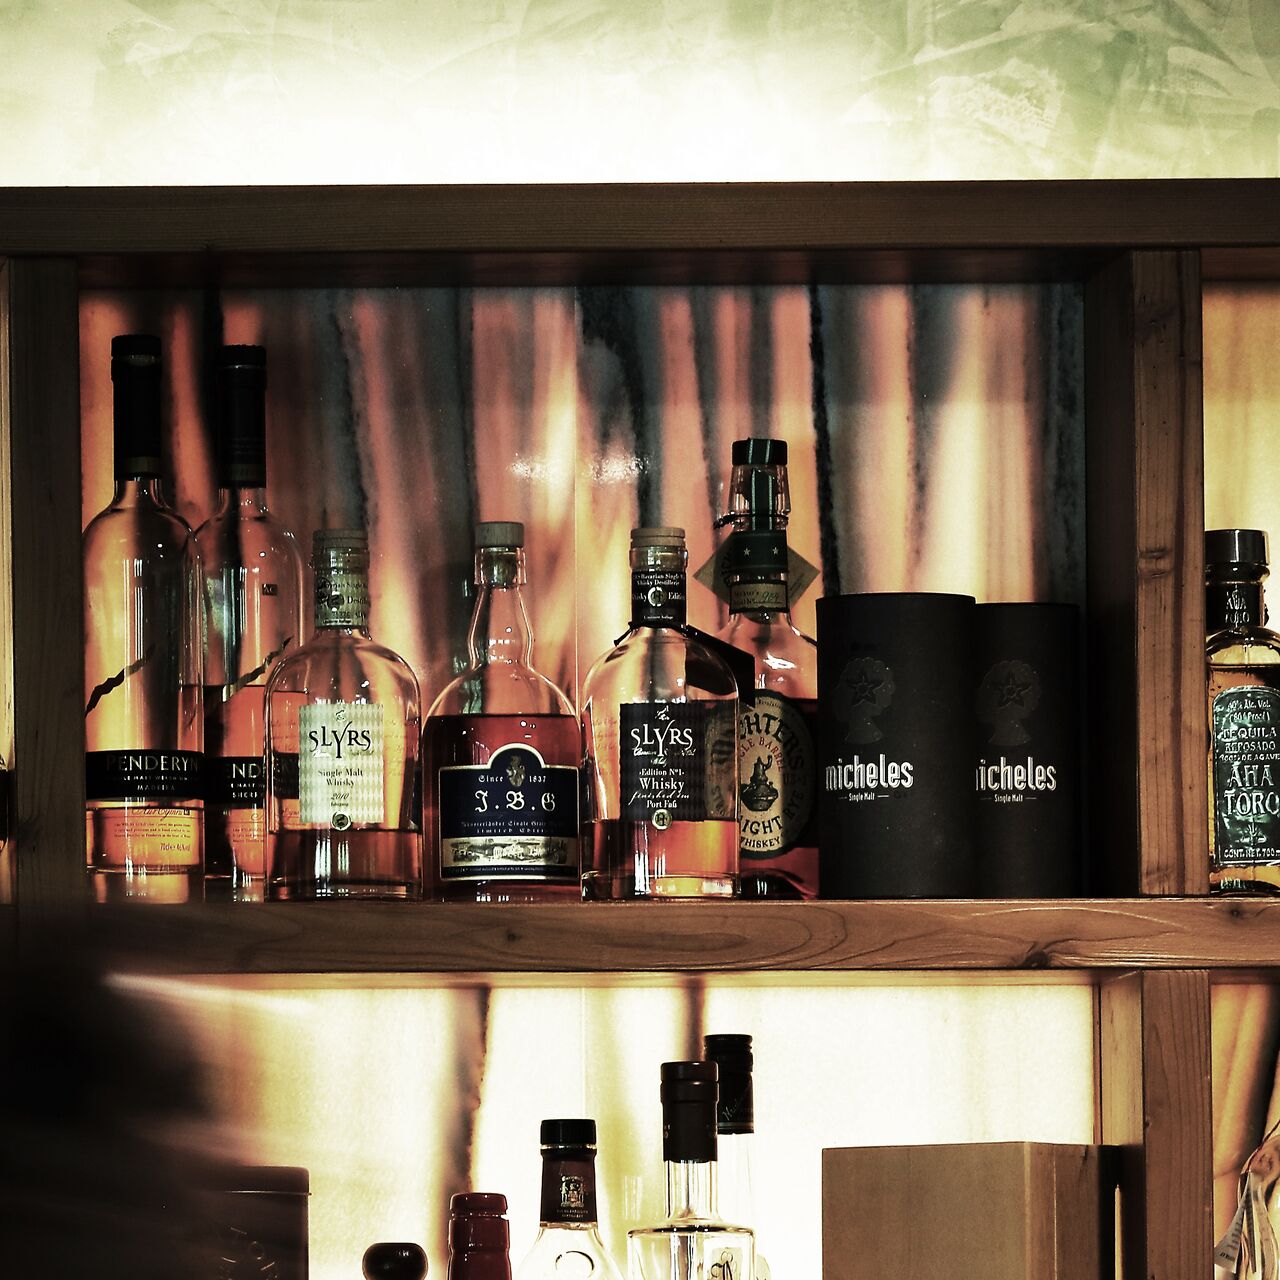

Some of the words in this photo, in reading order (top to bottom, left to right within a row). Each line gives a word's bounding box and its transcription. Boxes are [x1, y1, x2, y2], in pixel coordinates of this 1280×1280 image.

[631, 721, 692, 756] SLYRS
[1225, 728, 1277, 739] TEQUILA
[1226, 742, 1276, 751] REPOSADO
[326, 778, 355, 787] Whisky
[1229, 765, 1274, 788] AHA
[640, 778, 684, 791] Whisky
